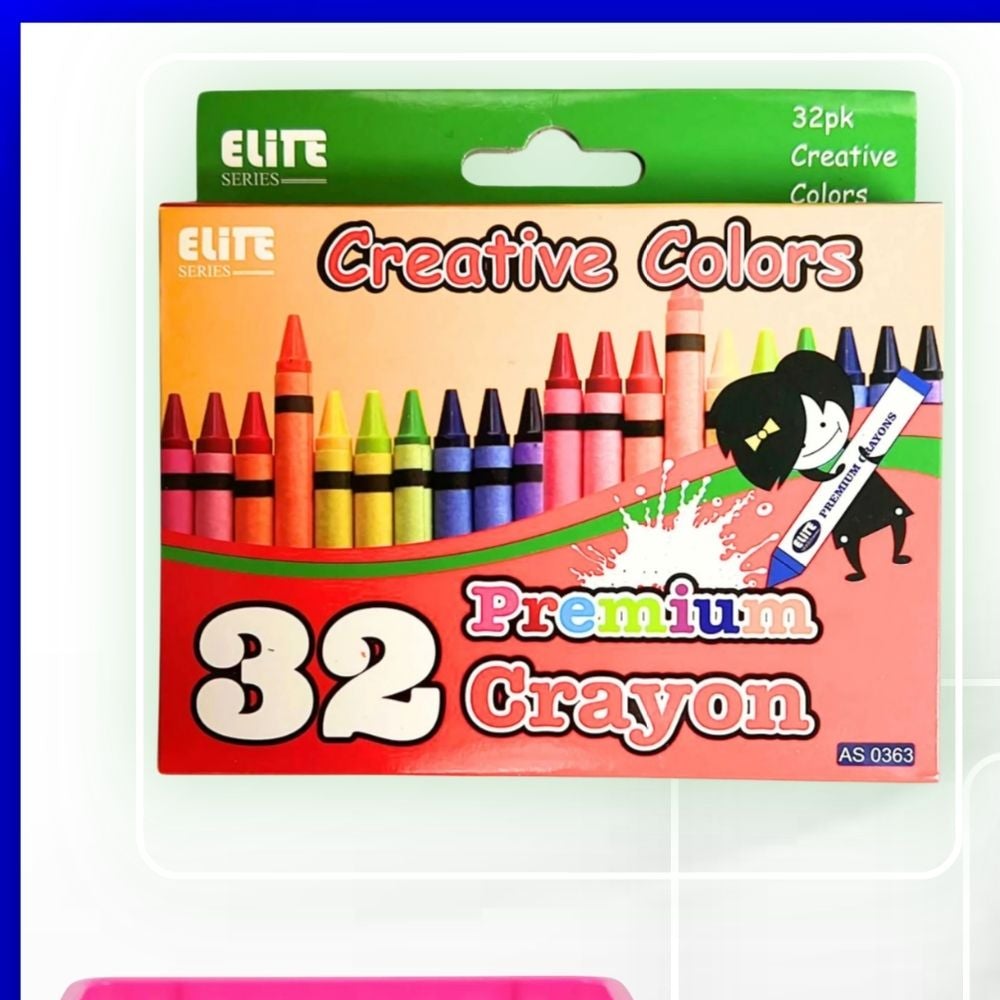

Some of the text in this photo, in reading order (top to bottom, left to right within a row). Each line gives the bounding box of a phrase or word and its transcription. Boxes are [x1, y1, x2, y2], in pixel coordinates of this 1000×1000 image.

[792, 104, 854, 136] 32pk
[791, 143, 898, 168] Creative
[221, 172, 280, 187] SERIES
[790, 181, 868, 204] Colors
[319, 216, 862, 293] Creative Colors
[178, 264, 232, 278] SERIES
[819, 463, 861, 519] PREMIUM
[462, 574, 823, 645] Premium
[191, 602, 444, 747] 32
[462, 656, 820, 754] Crayon
[838, 747, 914, 763] AS 0363
